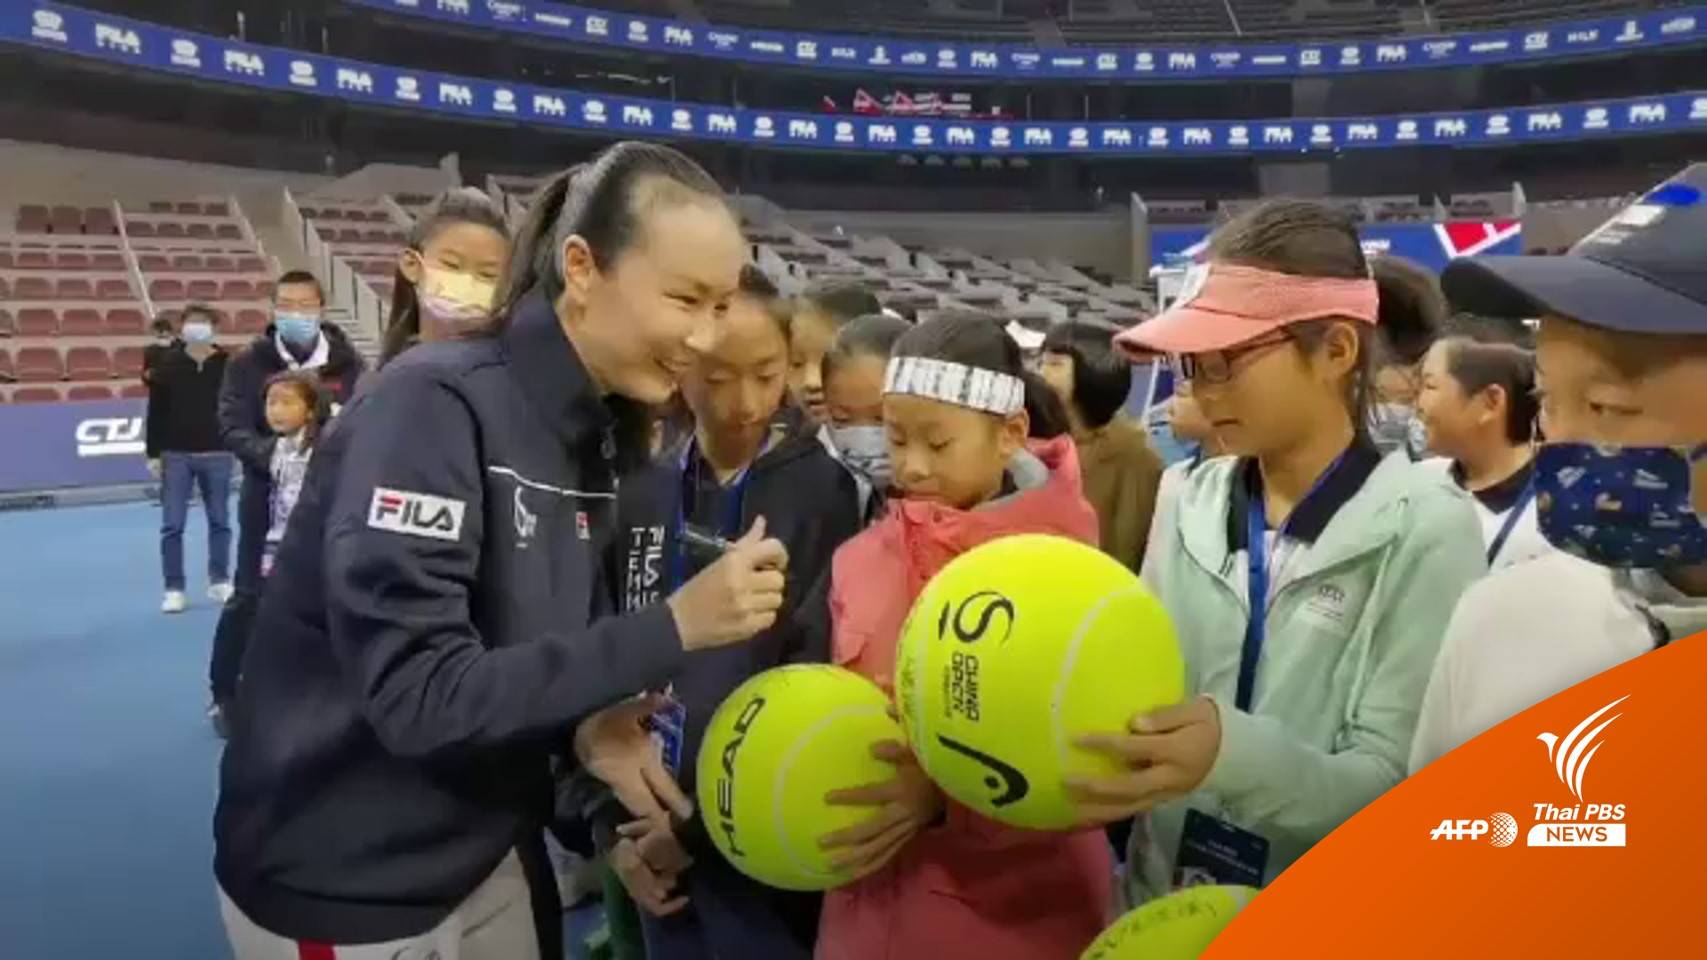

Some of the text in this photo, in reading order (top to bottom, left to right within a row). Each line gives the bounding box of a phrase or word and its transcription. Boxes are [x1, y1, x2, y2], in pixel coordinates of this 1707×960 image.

[376, 496, 455, 532] FILA
[642, 525, 665, 589] FILA
[716, 697, 767, 857] HEAD
